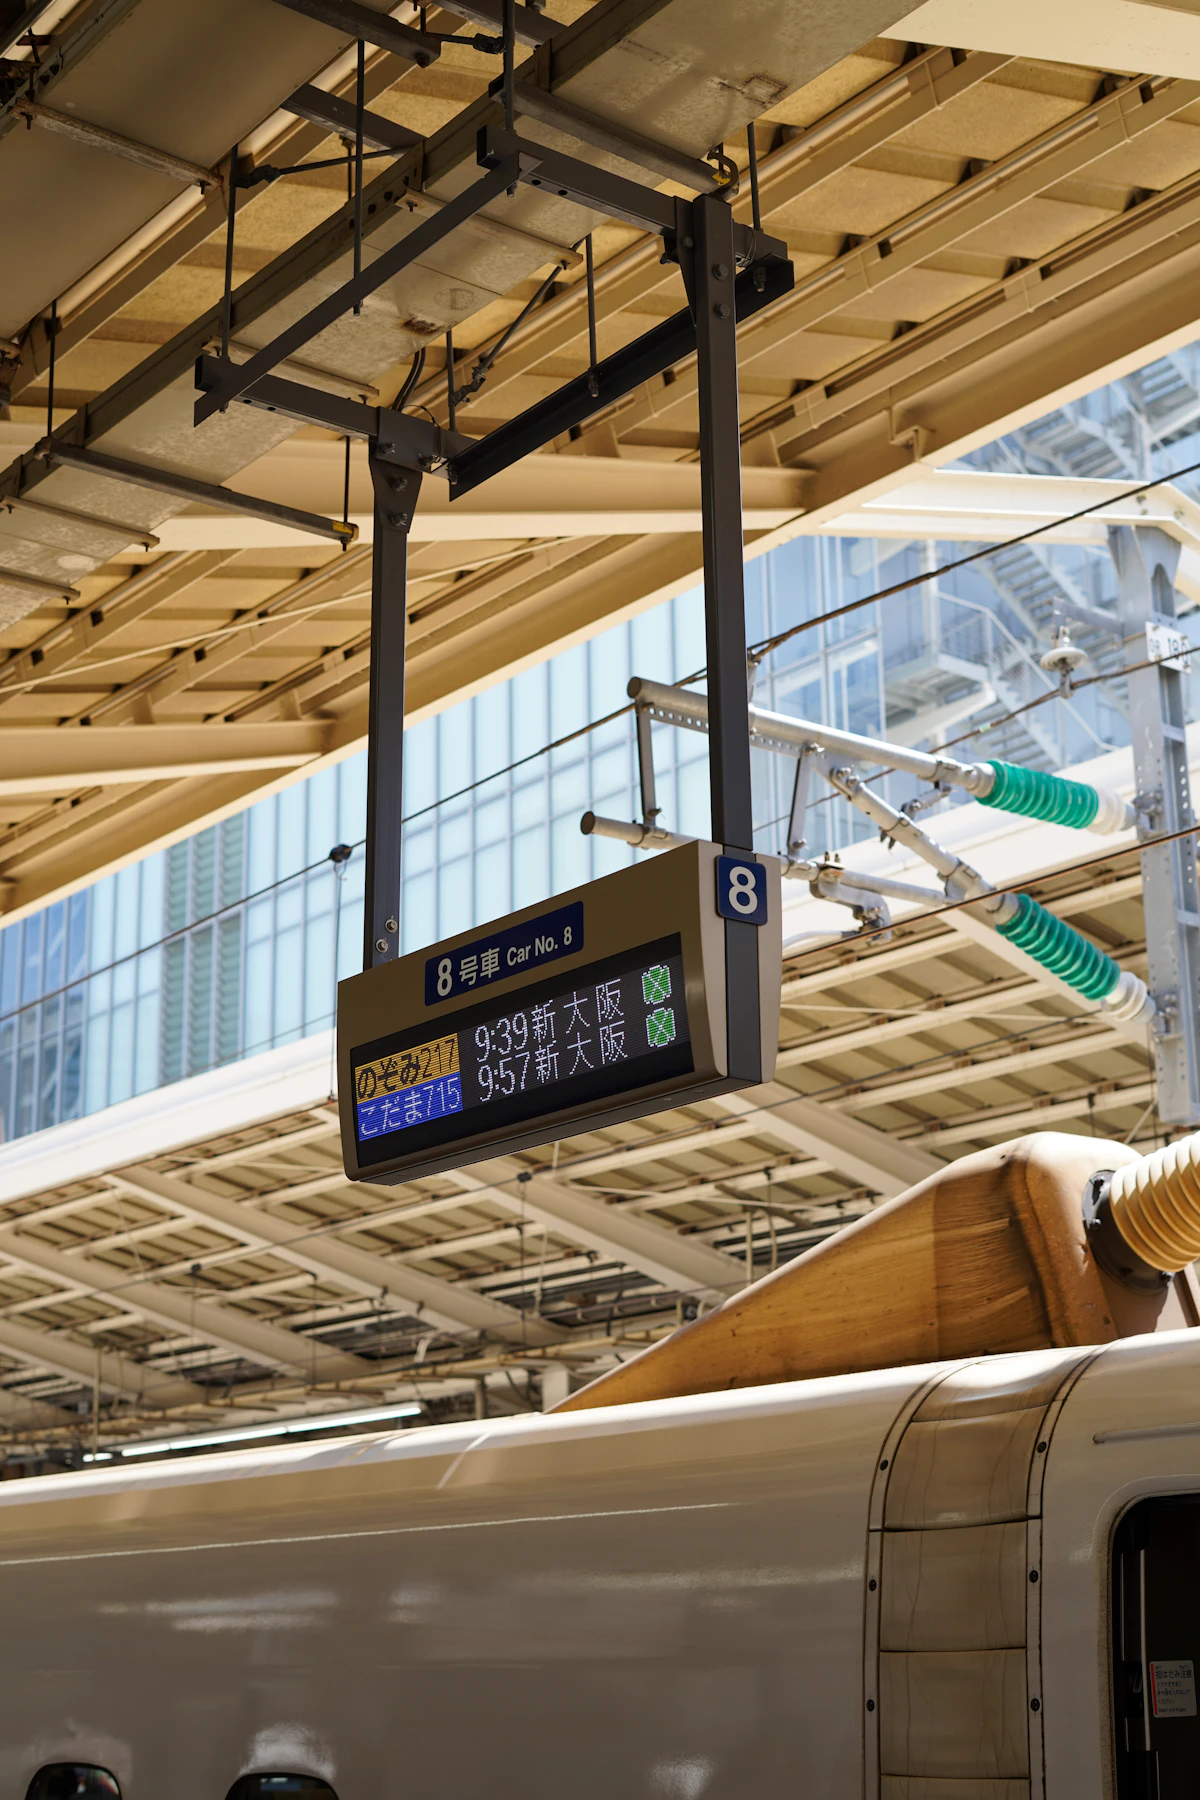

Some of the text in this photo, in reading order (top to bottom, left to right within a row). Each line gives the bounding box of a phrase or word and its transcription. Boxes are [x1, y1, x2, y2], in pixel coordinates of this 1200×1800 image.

[728, 866, 758, 915] 8
[506, 944, 531, 966] Car
[535, 935, 558, 957] No.
[563, 925, 572, 946] 8
[357, 978, 624, 1099] のぞみ217 9:39 新大阪
[361, 1020, 628, 1135] こだま715 9:57 新大阪
